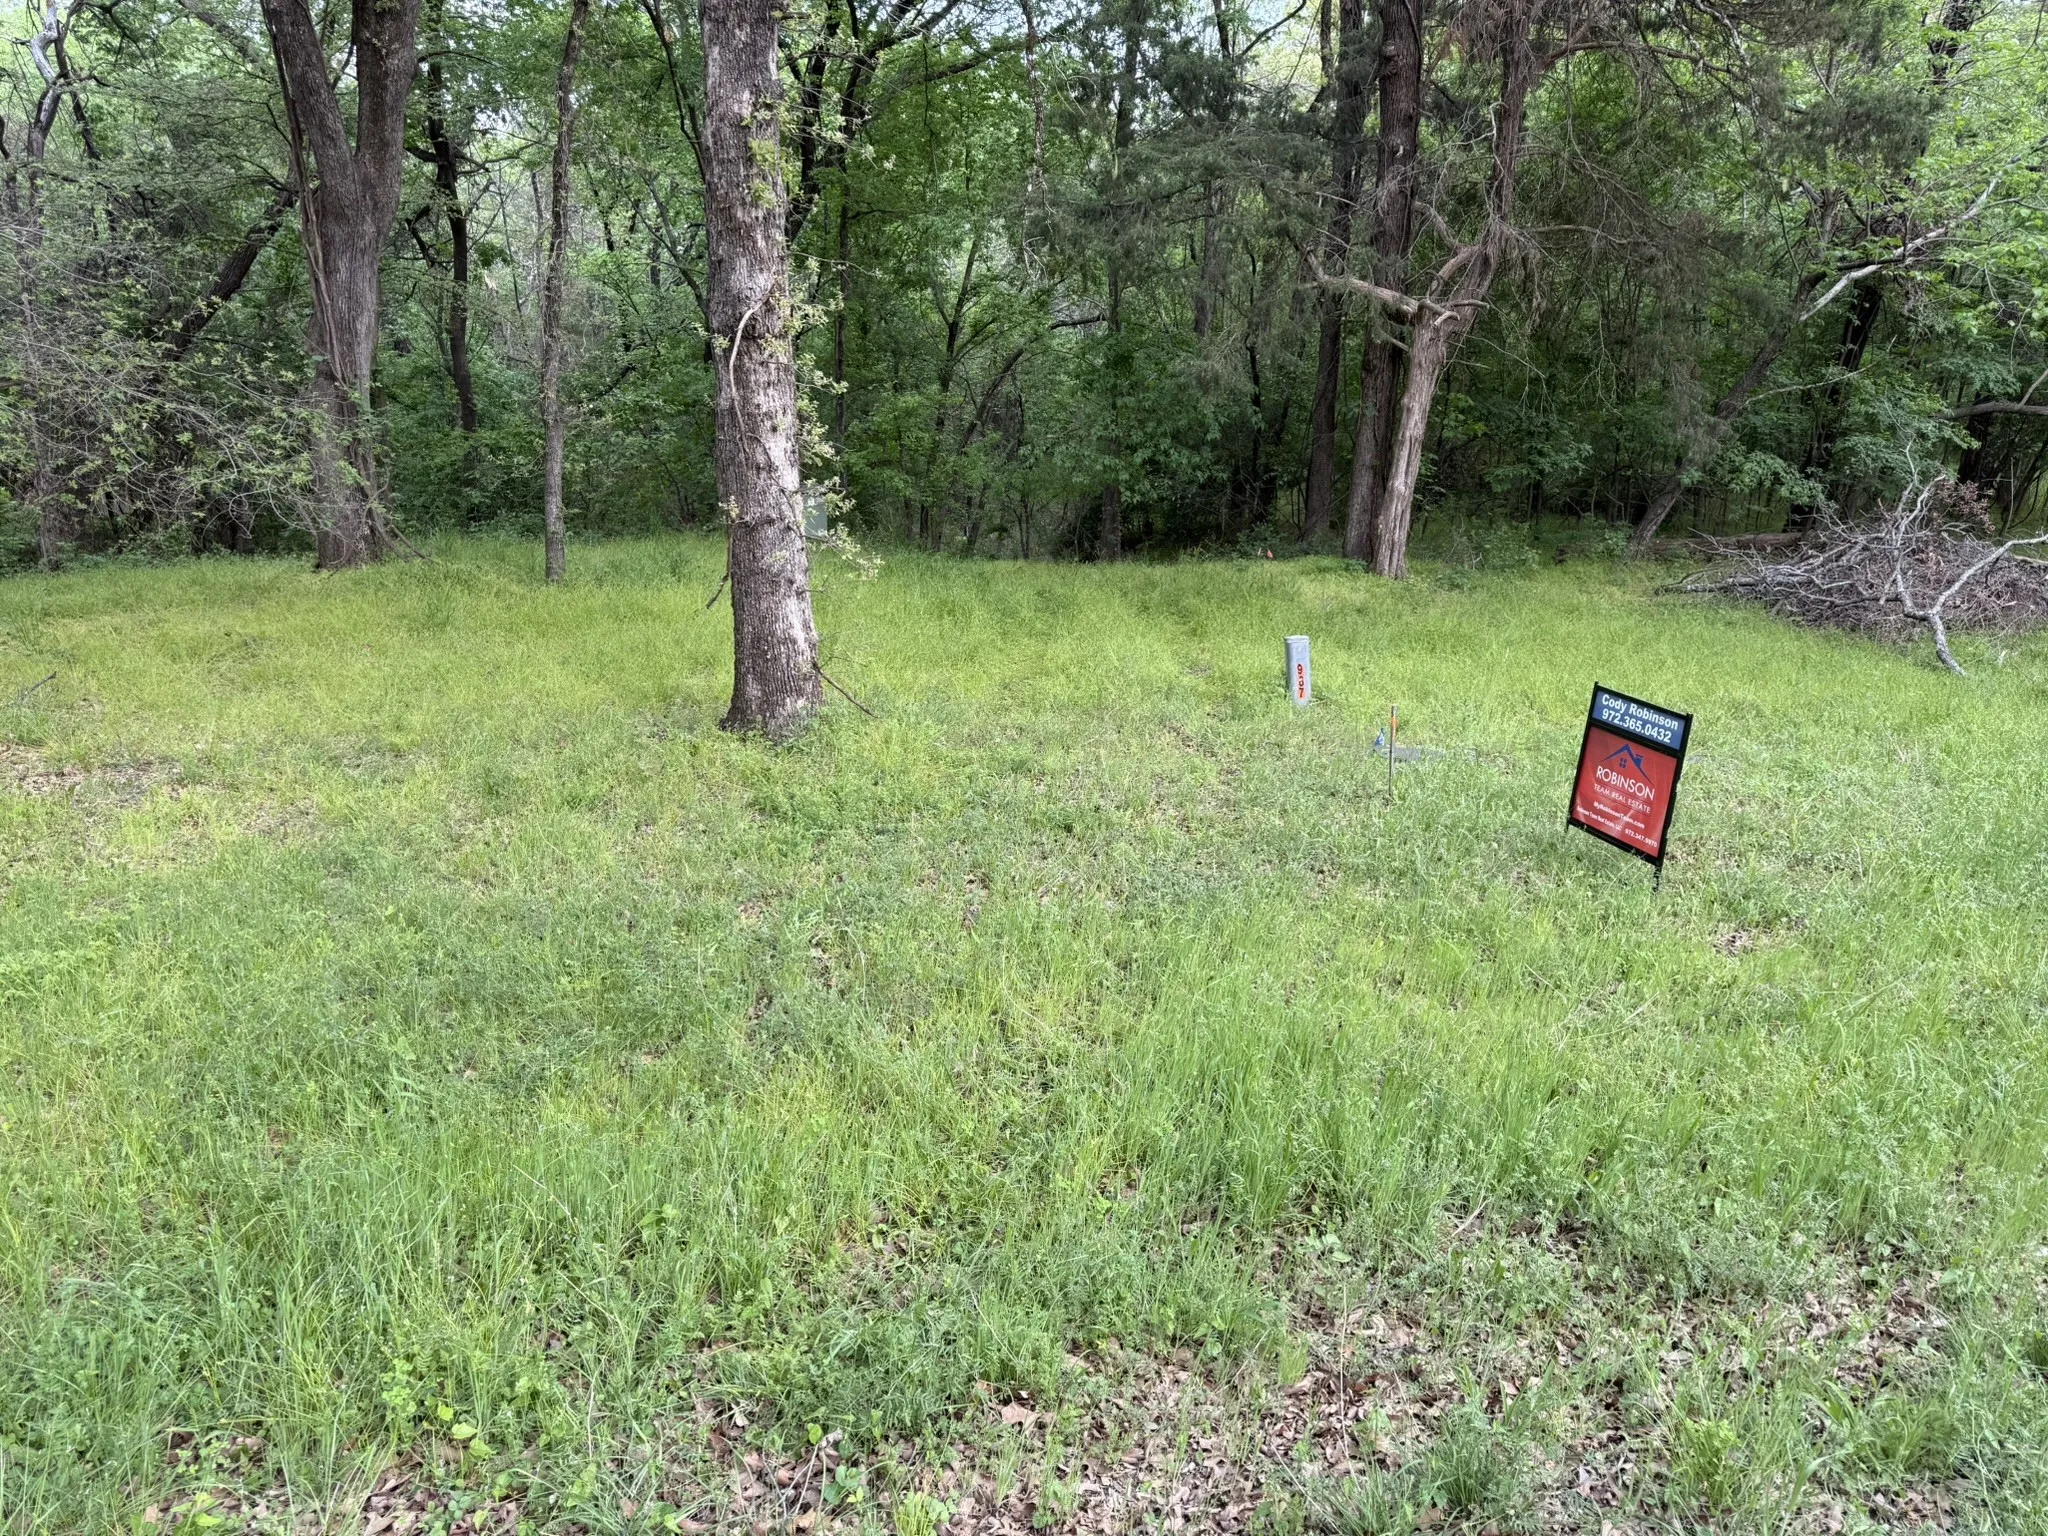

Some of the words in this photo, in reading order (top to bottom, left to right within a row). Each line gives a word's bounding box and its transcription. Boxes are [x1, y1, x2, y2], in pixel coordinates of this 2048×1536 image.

[1602, 694, 1627, 713] Cody
[1629, 703, 1679, 730] Robinson
[1602, 708, 1672, 743] 972.365.0432
[1594, 783, 1610, 796] TEAM
[1611, 792, 1627, 804] REAL
[1628, 799, 1651, 814] ESTATE
[1596, 765, 1656, 801] ROBINSON
[1593, 801, 1645, 829] MyRobinsonTeam.com
